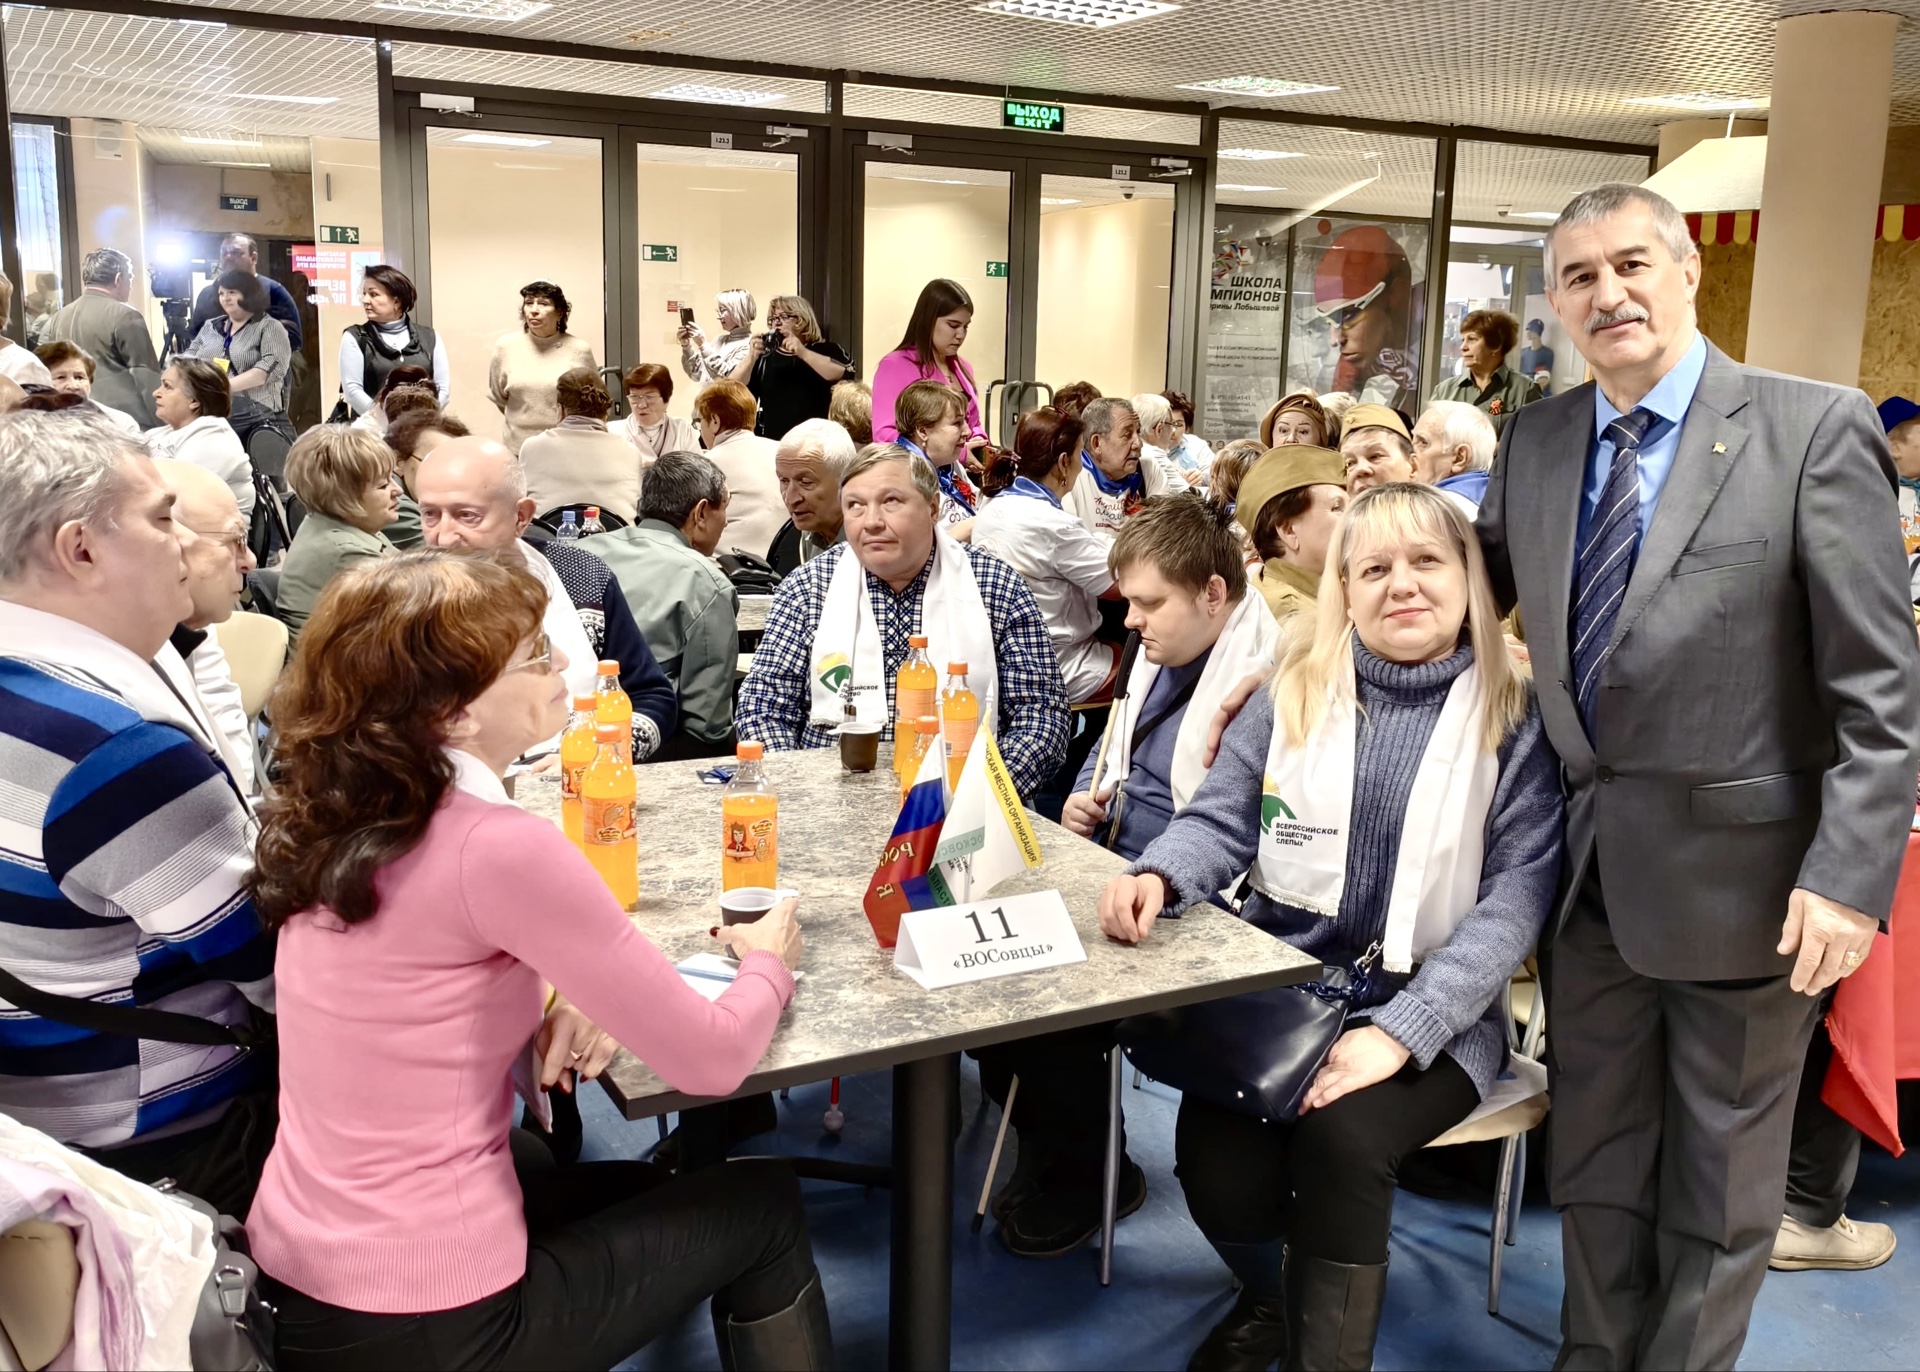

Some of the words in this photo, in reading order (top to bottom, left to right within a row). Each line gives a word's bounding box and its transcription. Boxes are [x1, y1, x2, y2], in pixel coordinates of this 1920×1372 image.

[1007, 103, 1060, 122] ВЫХОД
[1014, 116, 1053, 129] EXIT
[1231, 276, 1281, 289] ШКОЛА
[1210, 289, 1281, 302] МПИОНОВ
[1210, 303, 1232, 311] рины
[1234, 303, 1280, 311] Лобышевой
[993, 772, 1014, 808] МЕСТНАЯ
[1008, 806, 1037, 863] ОРГАНИЗАЦИЯ
[1276, 822, 1339, 835] ВСЕРОССИЙСКОЕ
[1276, 830, 1313, 841] ОБЩЕСТВО
[1276, 838, 1304, 847] СЛЕПЫХ
[965, 906, 1019, 944] 11
[953, 943, 1053, 969] «ВОСовцы»
